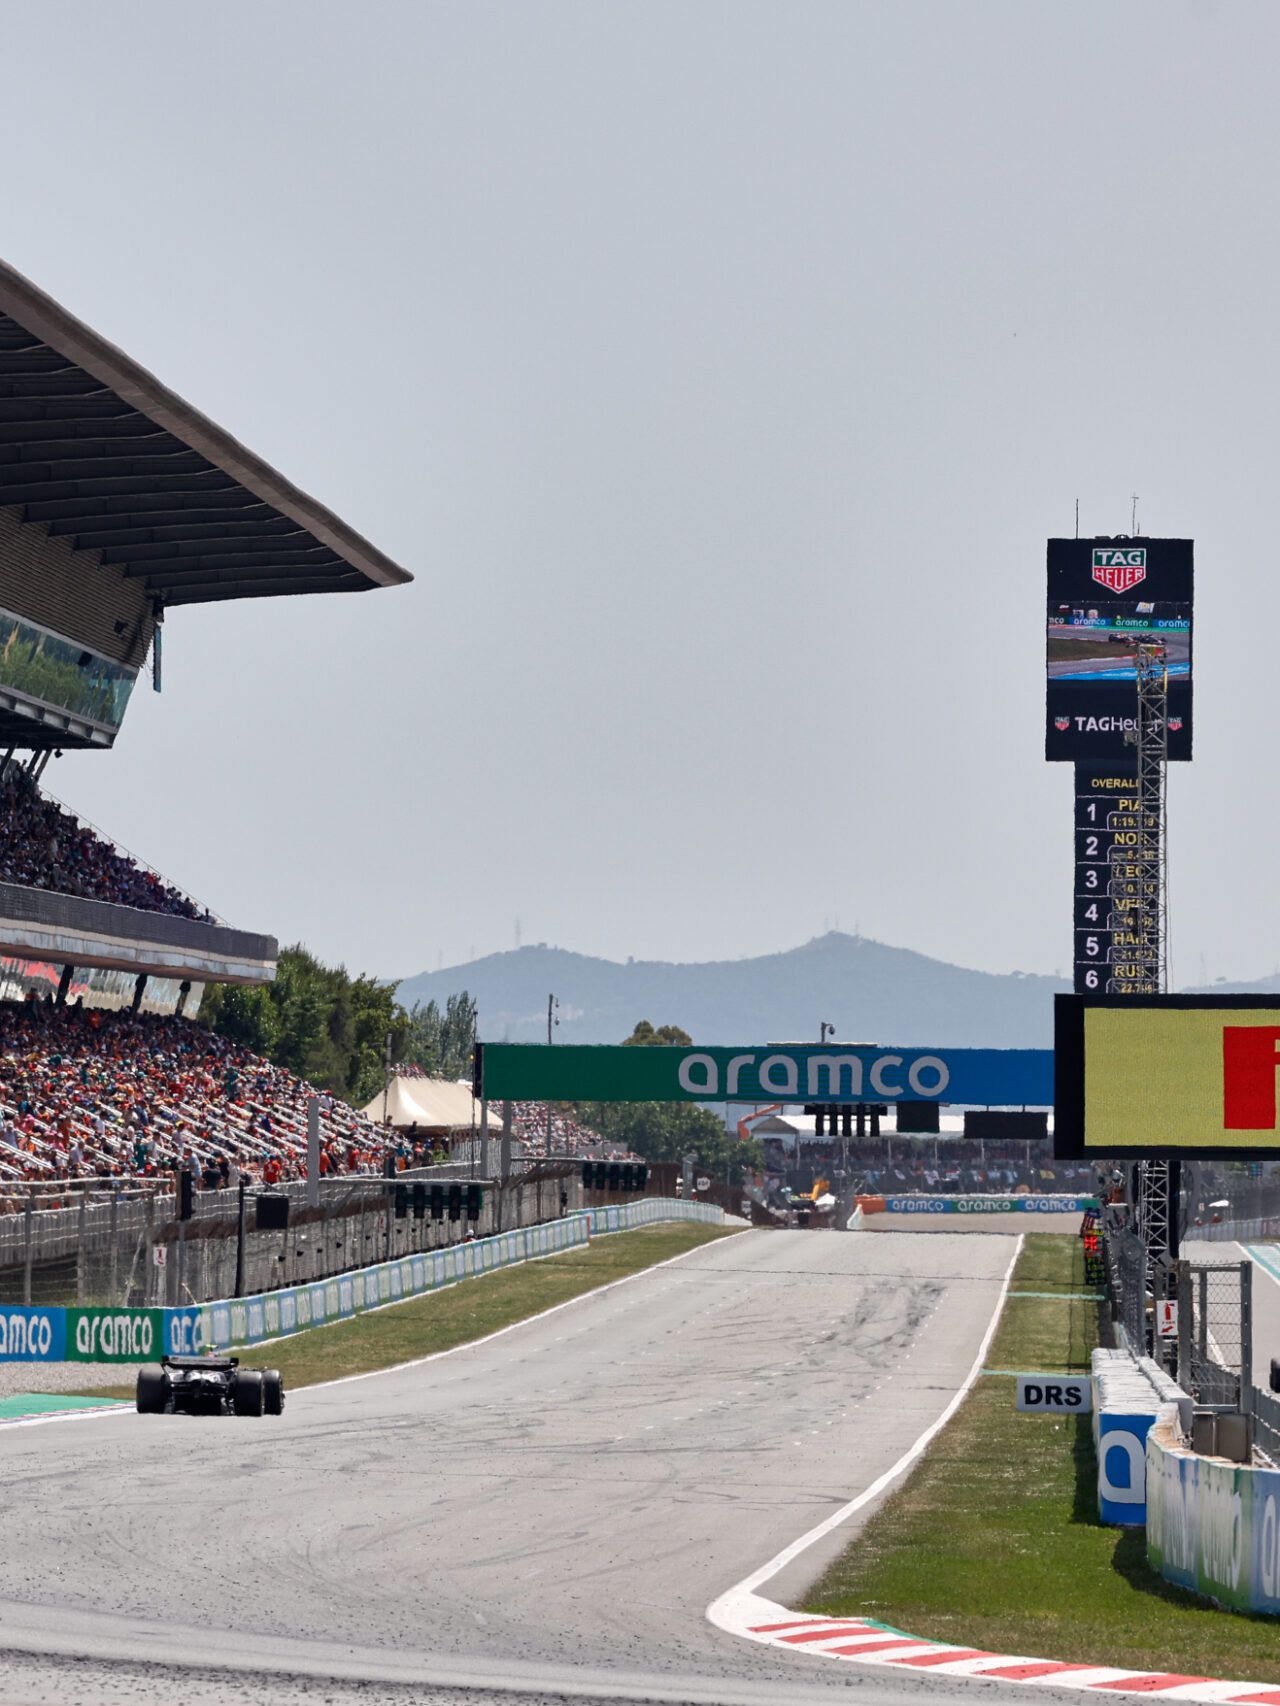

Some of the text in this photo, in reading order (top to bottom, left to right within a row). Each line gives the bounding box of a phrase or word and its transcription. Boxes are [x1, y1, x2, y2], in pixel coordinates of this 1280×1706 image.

[1097, 552, 1141, 565] TAG
[1096, 569, 1142, 590] HEUER
[1074, 617, 1106, 625] aramco
[1115, 619, 1148, 627] aramco
[1087, 803, 1096, 821] 1
[1119, 799, 1143, 811] PIA
[1086, 836, 1098, 856] 2
[1114, 832, 1147, 845] NO
[1085, 870, 1098, 888] 3
[1085, 903, 1098, 922] 4
[1086, 936, 1099, 956] 5
[1085, 969, 1099, 989] 6
[679, 1054, 949, 1096] aramco
[892, 1200, 945, 1212] aramco
[957, 1200, 1012, 1213] aramco
[1025, 1200, 1076, 1212] aramco
[76, 1315, 153, 1355] aramco
[1024, 1385, 1082, 1406] DRS
